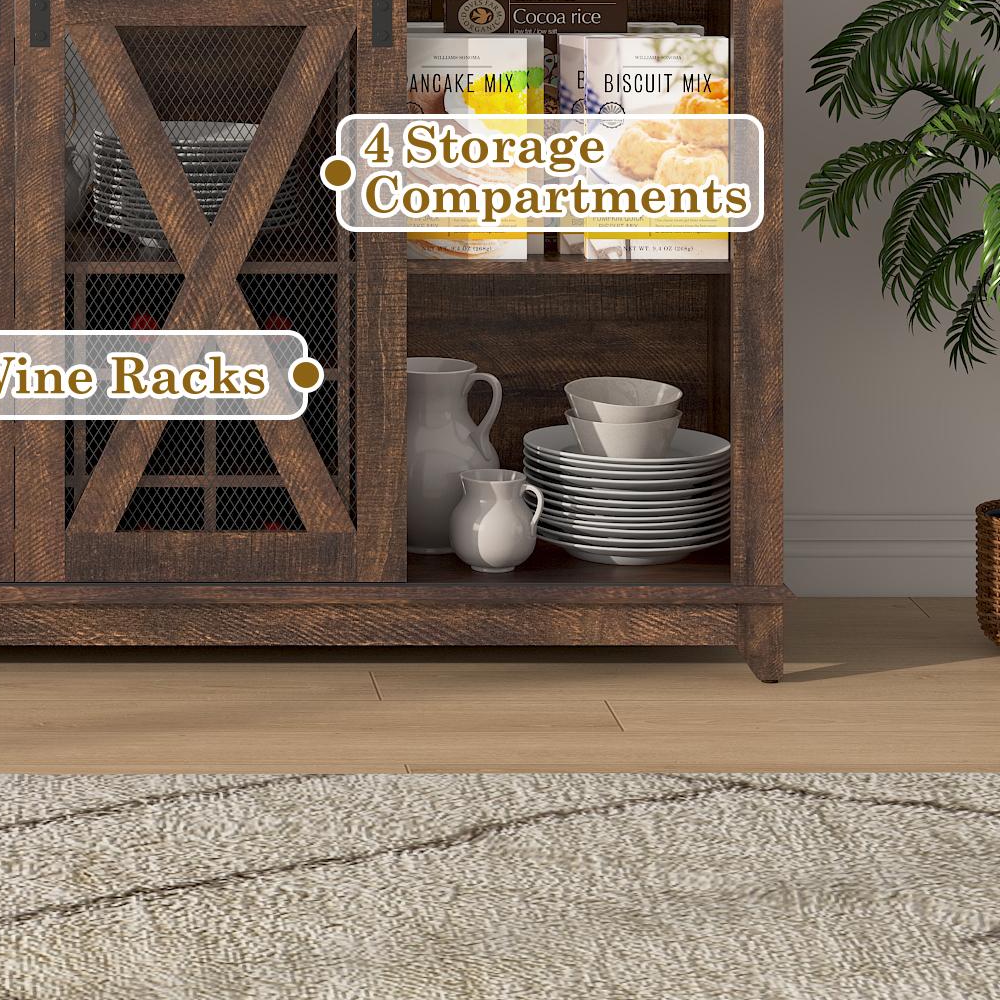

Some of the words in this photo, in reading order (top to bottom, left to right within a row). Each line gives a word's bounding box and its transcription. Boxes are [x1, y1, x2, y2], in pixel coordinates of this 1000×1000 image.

[513, 9, 566, 24] Cocoa
[571, 9, 601, 24] rice
[407, 73, 475, 93] ANCAKE
[484, 73, 514, 93] MIX
[604, 73, 673, 93] BISCUIT
[683, 73, 712, 93] MIX
